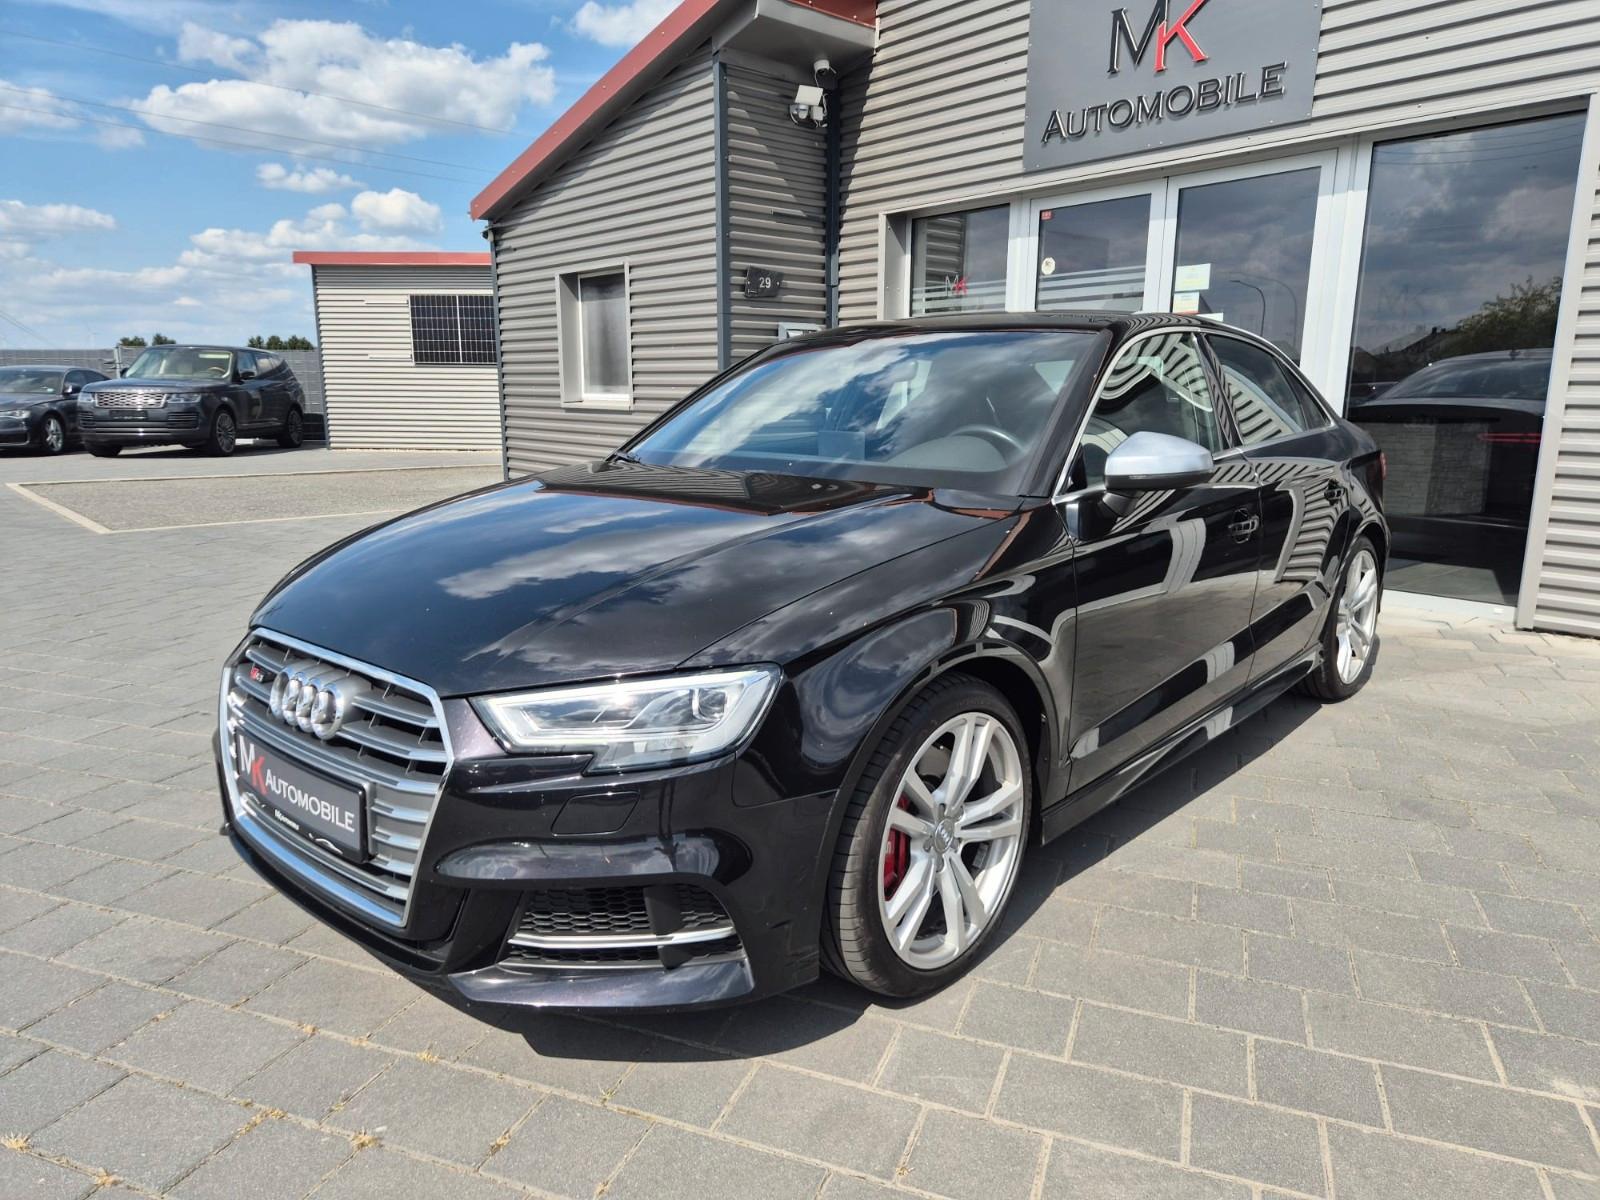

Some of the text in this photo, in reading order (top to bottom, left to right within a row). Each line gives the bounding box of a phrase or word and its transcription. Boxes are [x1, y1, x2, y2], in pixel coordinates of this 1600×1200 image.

[1107, 0, 1209, 73] MK
[1041, 60, 1288, 144] AUTOMOBILE
[759, 277, 771, 289] 29
[239, 735, 355, 832] MK AUTOMOBILE
